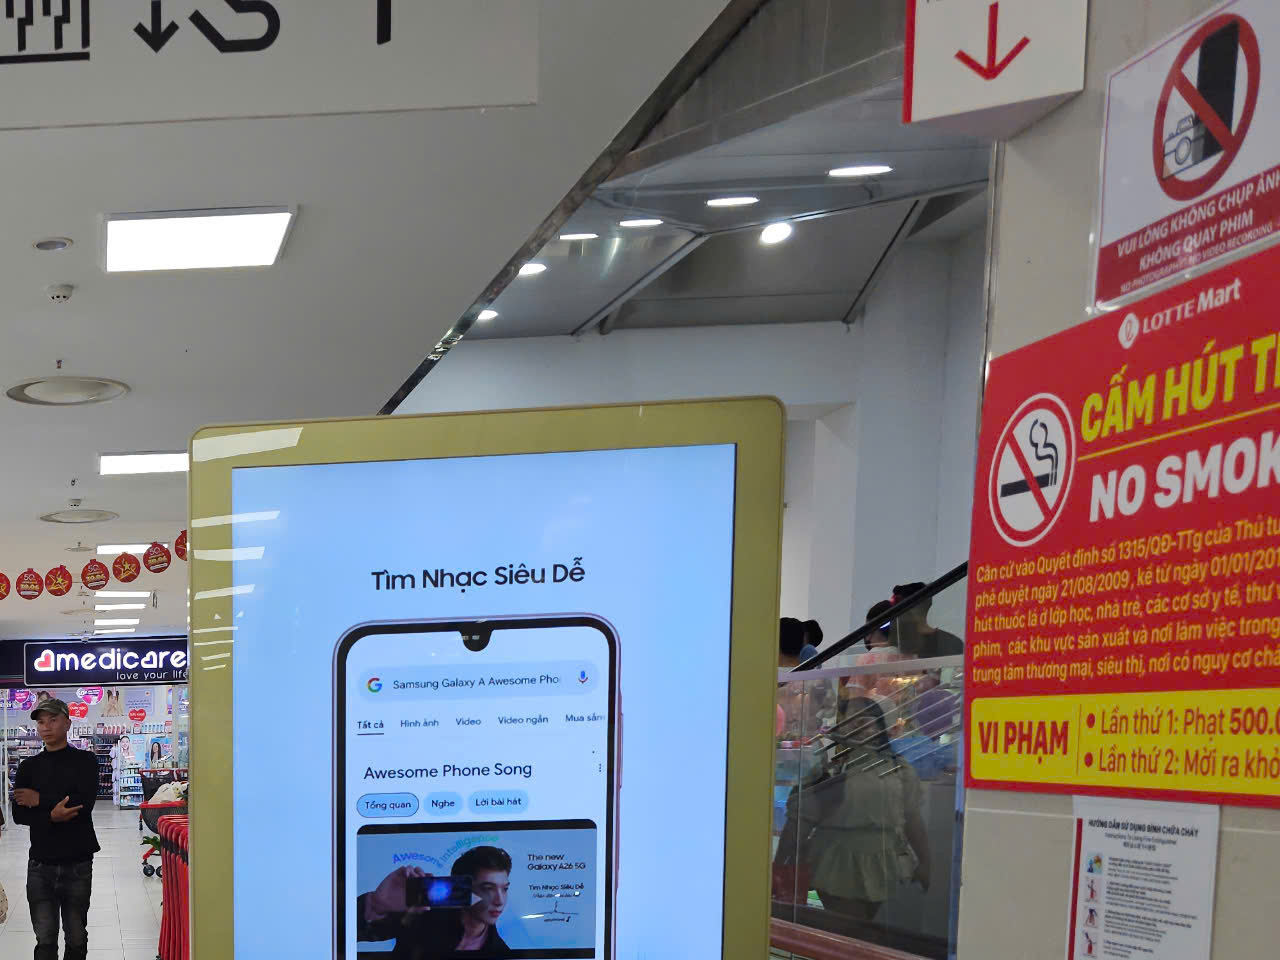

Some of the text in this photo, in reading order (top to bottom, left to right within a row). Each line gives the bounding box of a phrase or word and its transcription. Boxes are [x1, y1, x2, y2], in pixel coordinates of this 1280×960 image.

[1117, 237, 1138, 257] VUI
[1218, 182, 1254, 212] CHỤP
[1139, 208, 1253, 272] KHÔNG QUAY PHIM
[1143, 278, 1242, 335] LOTTE Mart
[1080, 339, 1245, 444] CẤM HÚT
[1089, 463, 1147, 523] NO
[371, 556, 586, 594] Tìm Nhạc Siêu Dễ
[1030, 635, 1051, 653] khu
[56, 648, 188, 671] medicare
[116, 671, 139, 681] love
[143, 671, 169, 681] your
[973, 666, 1002, 686] trung
[1192, 652, 1231, 675] nguy
[392, 679, 439, 690] Samsung
[441, 678, 476, 689] Galaxy
[478, 677, 486, 687] A
[488, 677, 537, 686] Awesome
[356, 719, 385, 729] Tất cả
[400, 717, 440, 728] Hình ảnh
[455, 717, 482, 726] Video
[497, 715, 524, 725] Video
[565, 714, 585, 722] Mua
[1101, 705, 1129, 735] Lần
[1132, 705, 1164, 735] thứ
[1183, 706, 1226, 742] Phạt
[978, 719, 1070, 765] VI PHẠM
[1098, 744, 1127, 774] Lần
[1130, 746, 1161, 774] thứ
[1163, 748, 1179, 775] 2:
[1183, 746, 1217, 777] Mời
[1221, 755, 1240, 777] ra
[363, 762, 533, 780] Awesome Phone Song
[365, 800, 412, 811] Tổng quan
[431, 799, 456, 809] Nghe
[475, 797, 522, 807] Lời bài hát
[527, 853, 544, 861] The
[527, 863, 558, 872] Galaxy
[574, 862, 586, 870] 5G
